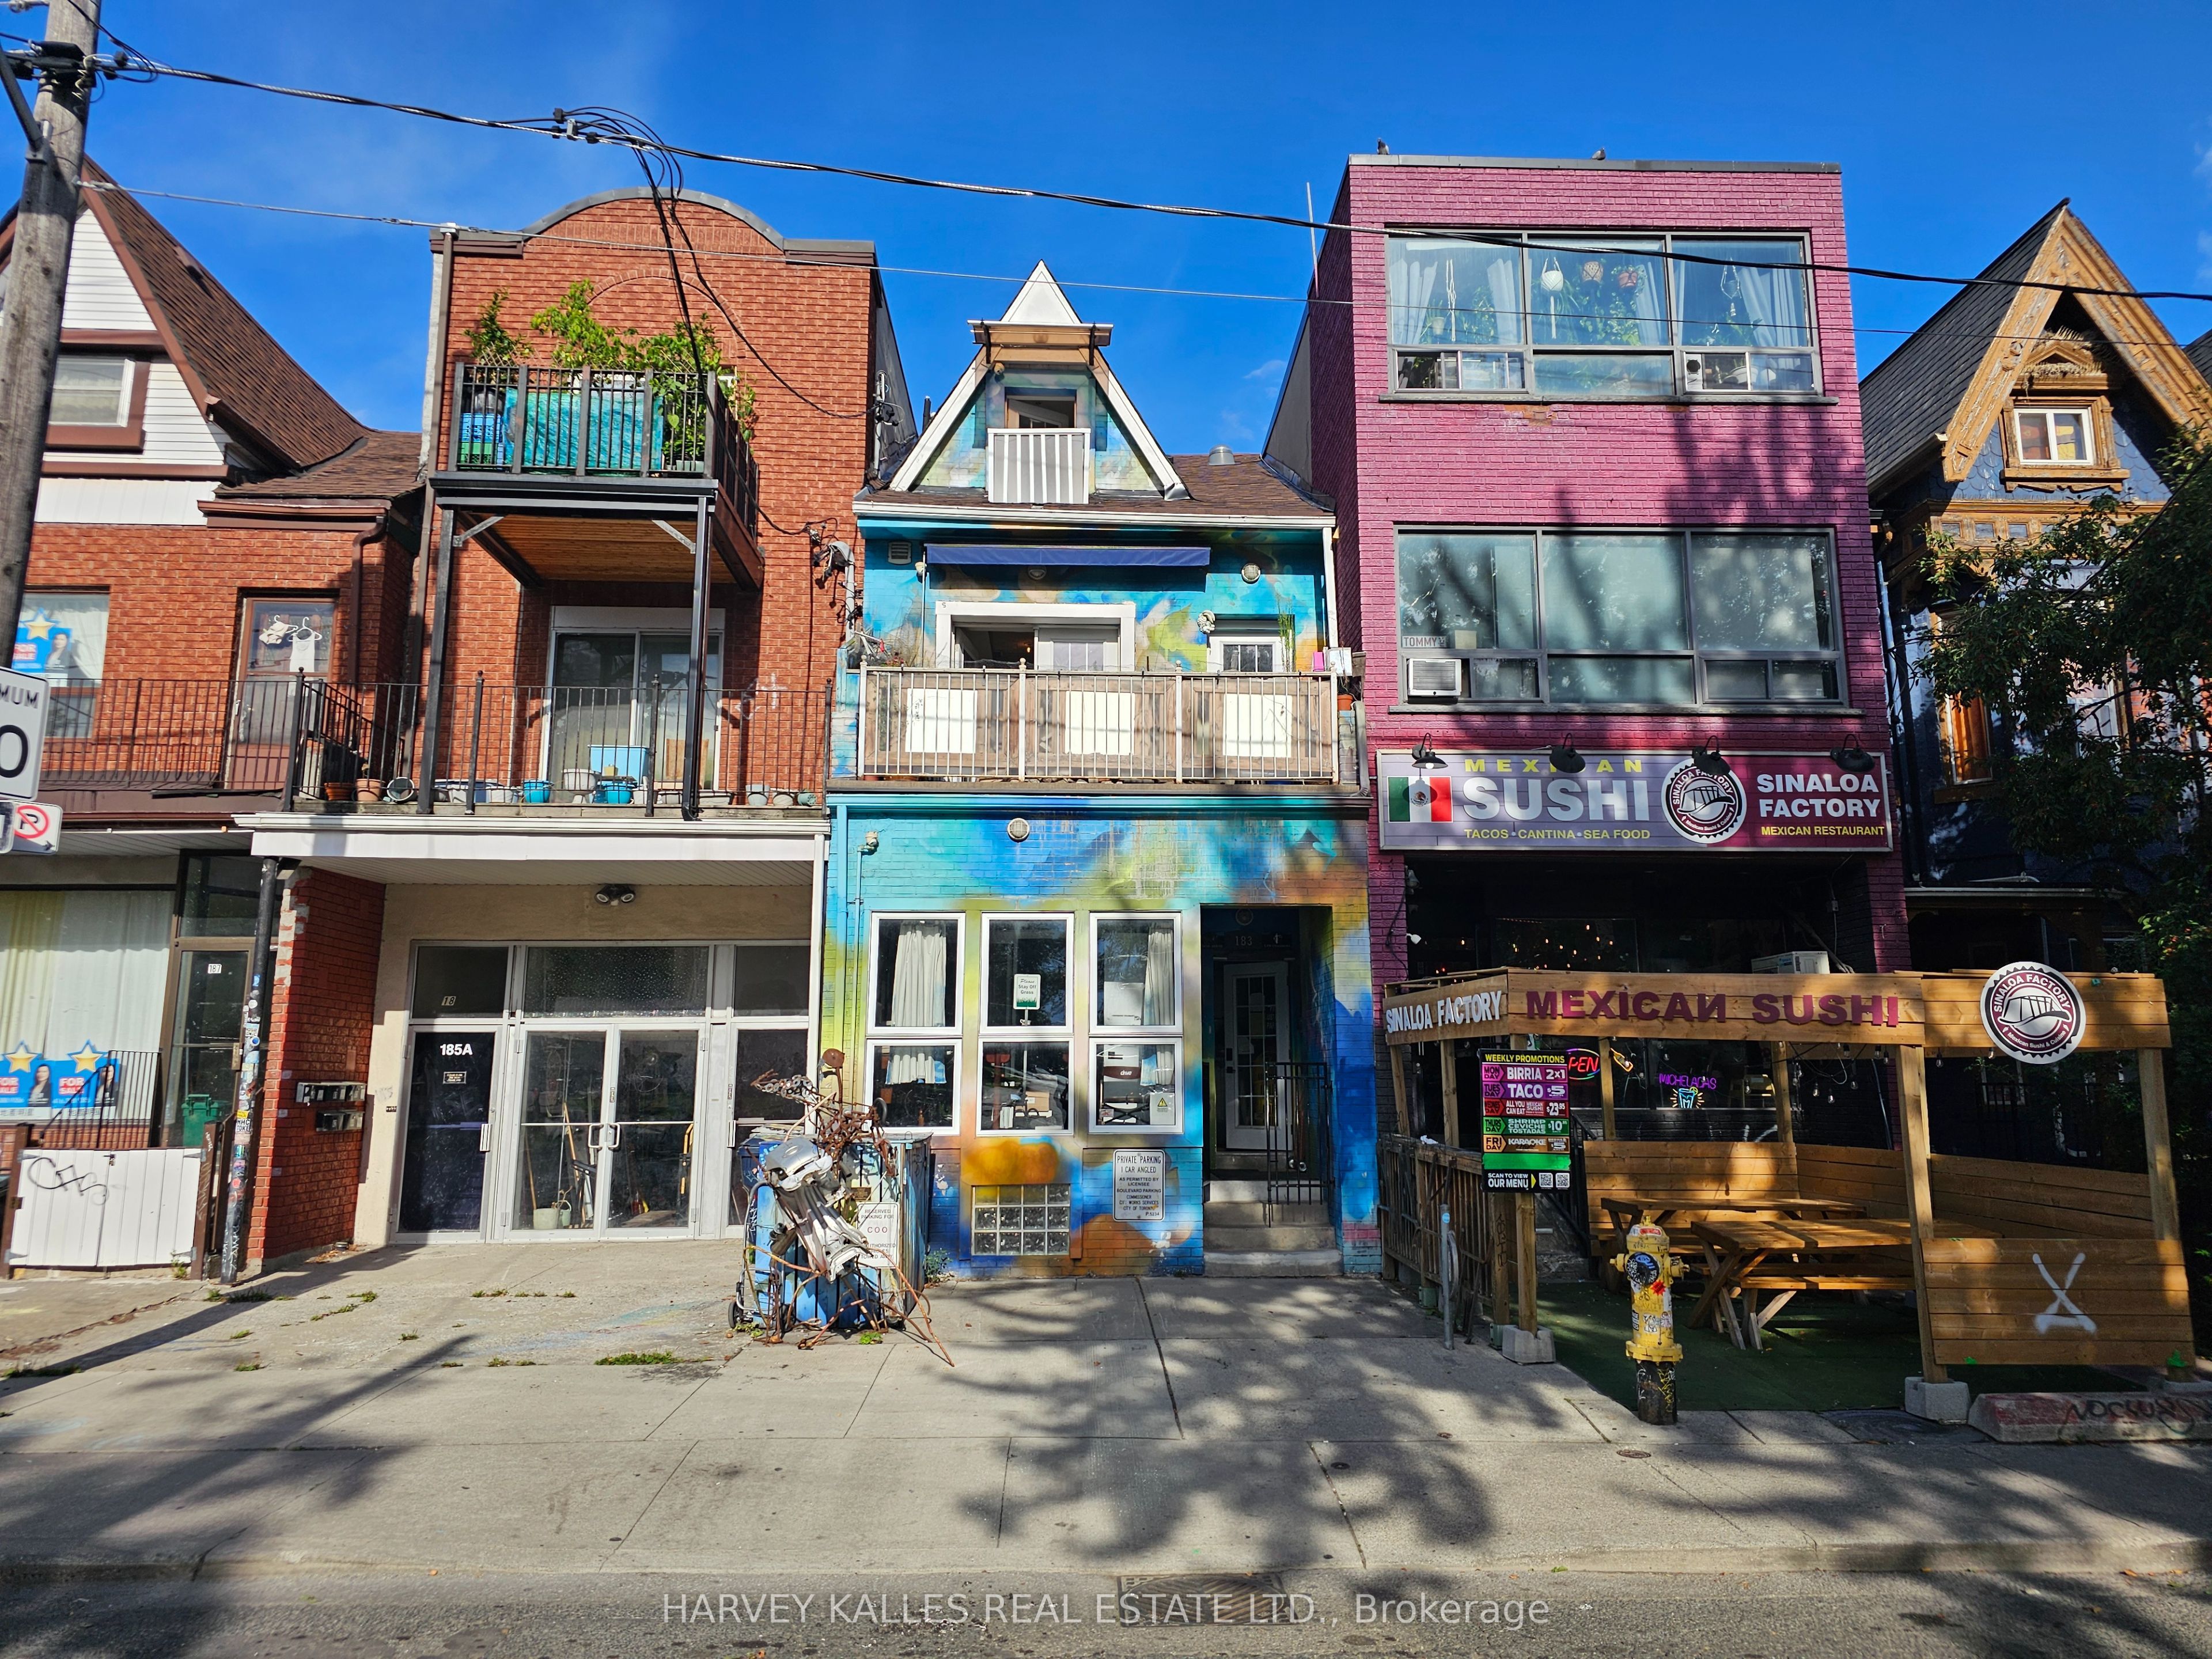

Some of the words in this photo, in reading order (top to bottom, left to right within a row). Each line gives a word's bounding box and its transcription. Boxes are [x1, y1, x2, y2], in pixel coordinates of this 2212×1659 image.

[1465, 759, 1642, 772] MEXIAN
[1673, 771, 1694, 805] SINALOA
[1757, 774, 1879, 793] SINALOA
[1463, 777, 1650, 821] SUSHI
[1759, 798, 1881, 817] FACTORY
[1685, 819, 1703, 831] Mexican
[1761, 826, 1811, 835] MEXICAN
[1814, 826, 1885, 835] RESTAURANT
[1464, 830, 1509, 839] TACOS
[1518, 830, 1576, 839] CANTINA
[1584, 830, 1610, 839] SEA
[1613, 830, 1650, 839] FOOD
[1236, 935, 1253, 946] 183
[209, 964, 221, 973] 187
[1994, 975, 2024, 1013] SINALOA
[2026, 974, 2071, 1008] FACTORY
[444, 997, 455, 1005] 18
[1386, 1003, 1433, 1033] SINALOA
[1437, 990, 1502, 1027] FACTORY
[1752, 994, 1899, 1027] SUSHI
[2008, 1032, 2029, 1047] Mexican
[2051, 1030, 2066, 1044] Cuisine
[440, 1044, 473, 1055] 185A
[1516, 1055, 1565, 1063] PROMOTIONS
[1569, 1057, 1599, 1071] PEN
[1507, 1067, 1542, 1080] BIRRIA
[1546, 1069, 1565, 1080] 2x1
[59, 1078, 85, 1086] FOR
[1508, 1084, 1543, 1099] TACO
[1547, 1085, 1565, 1094] $5
[1547, 1103, 1565, 1116] $23.95
[1485, 1119, 1502, 1127] THURS
[1486, 1137, 1502, 1145] FRI
[1117, 1156, 1137, 1164] PRIVATE
[1140, 1156, 1161, 1164] PARKING
[1488, 1179, 1505, 1187] OUR
[1506, 1179, 1528, 1188] MENU
